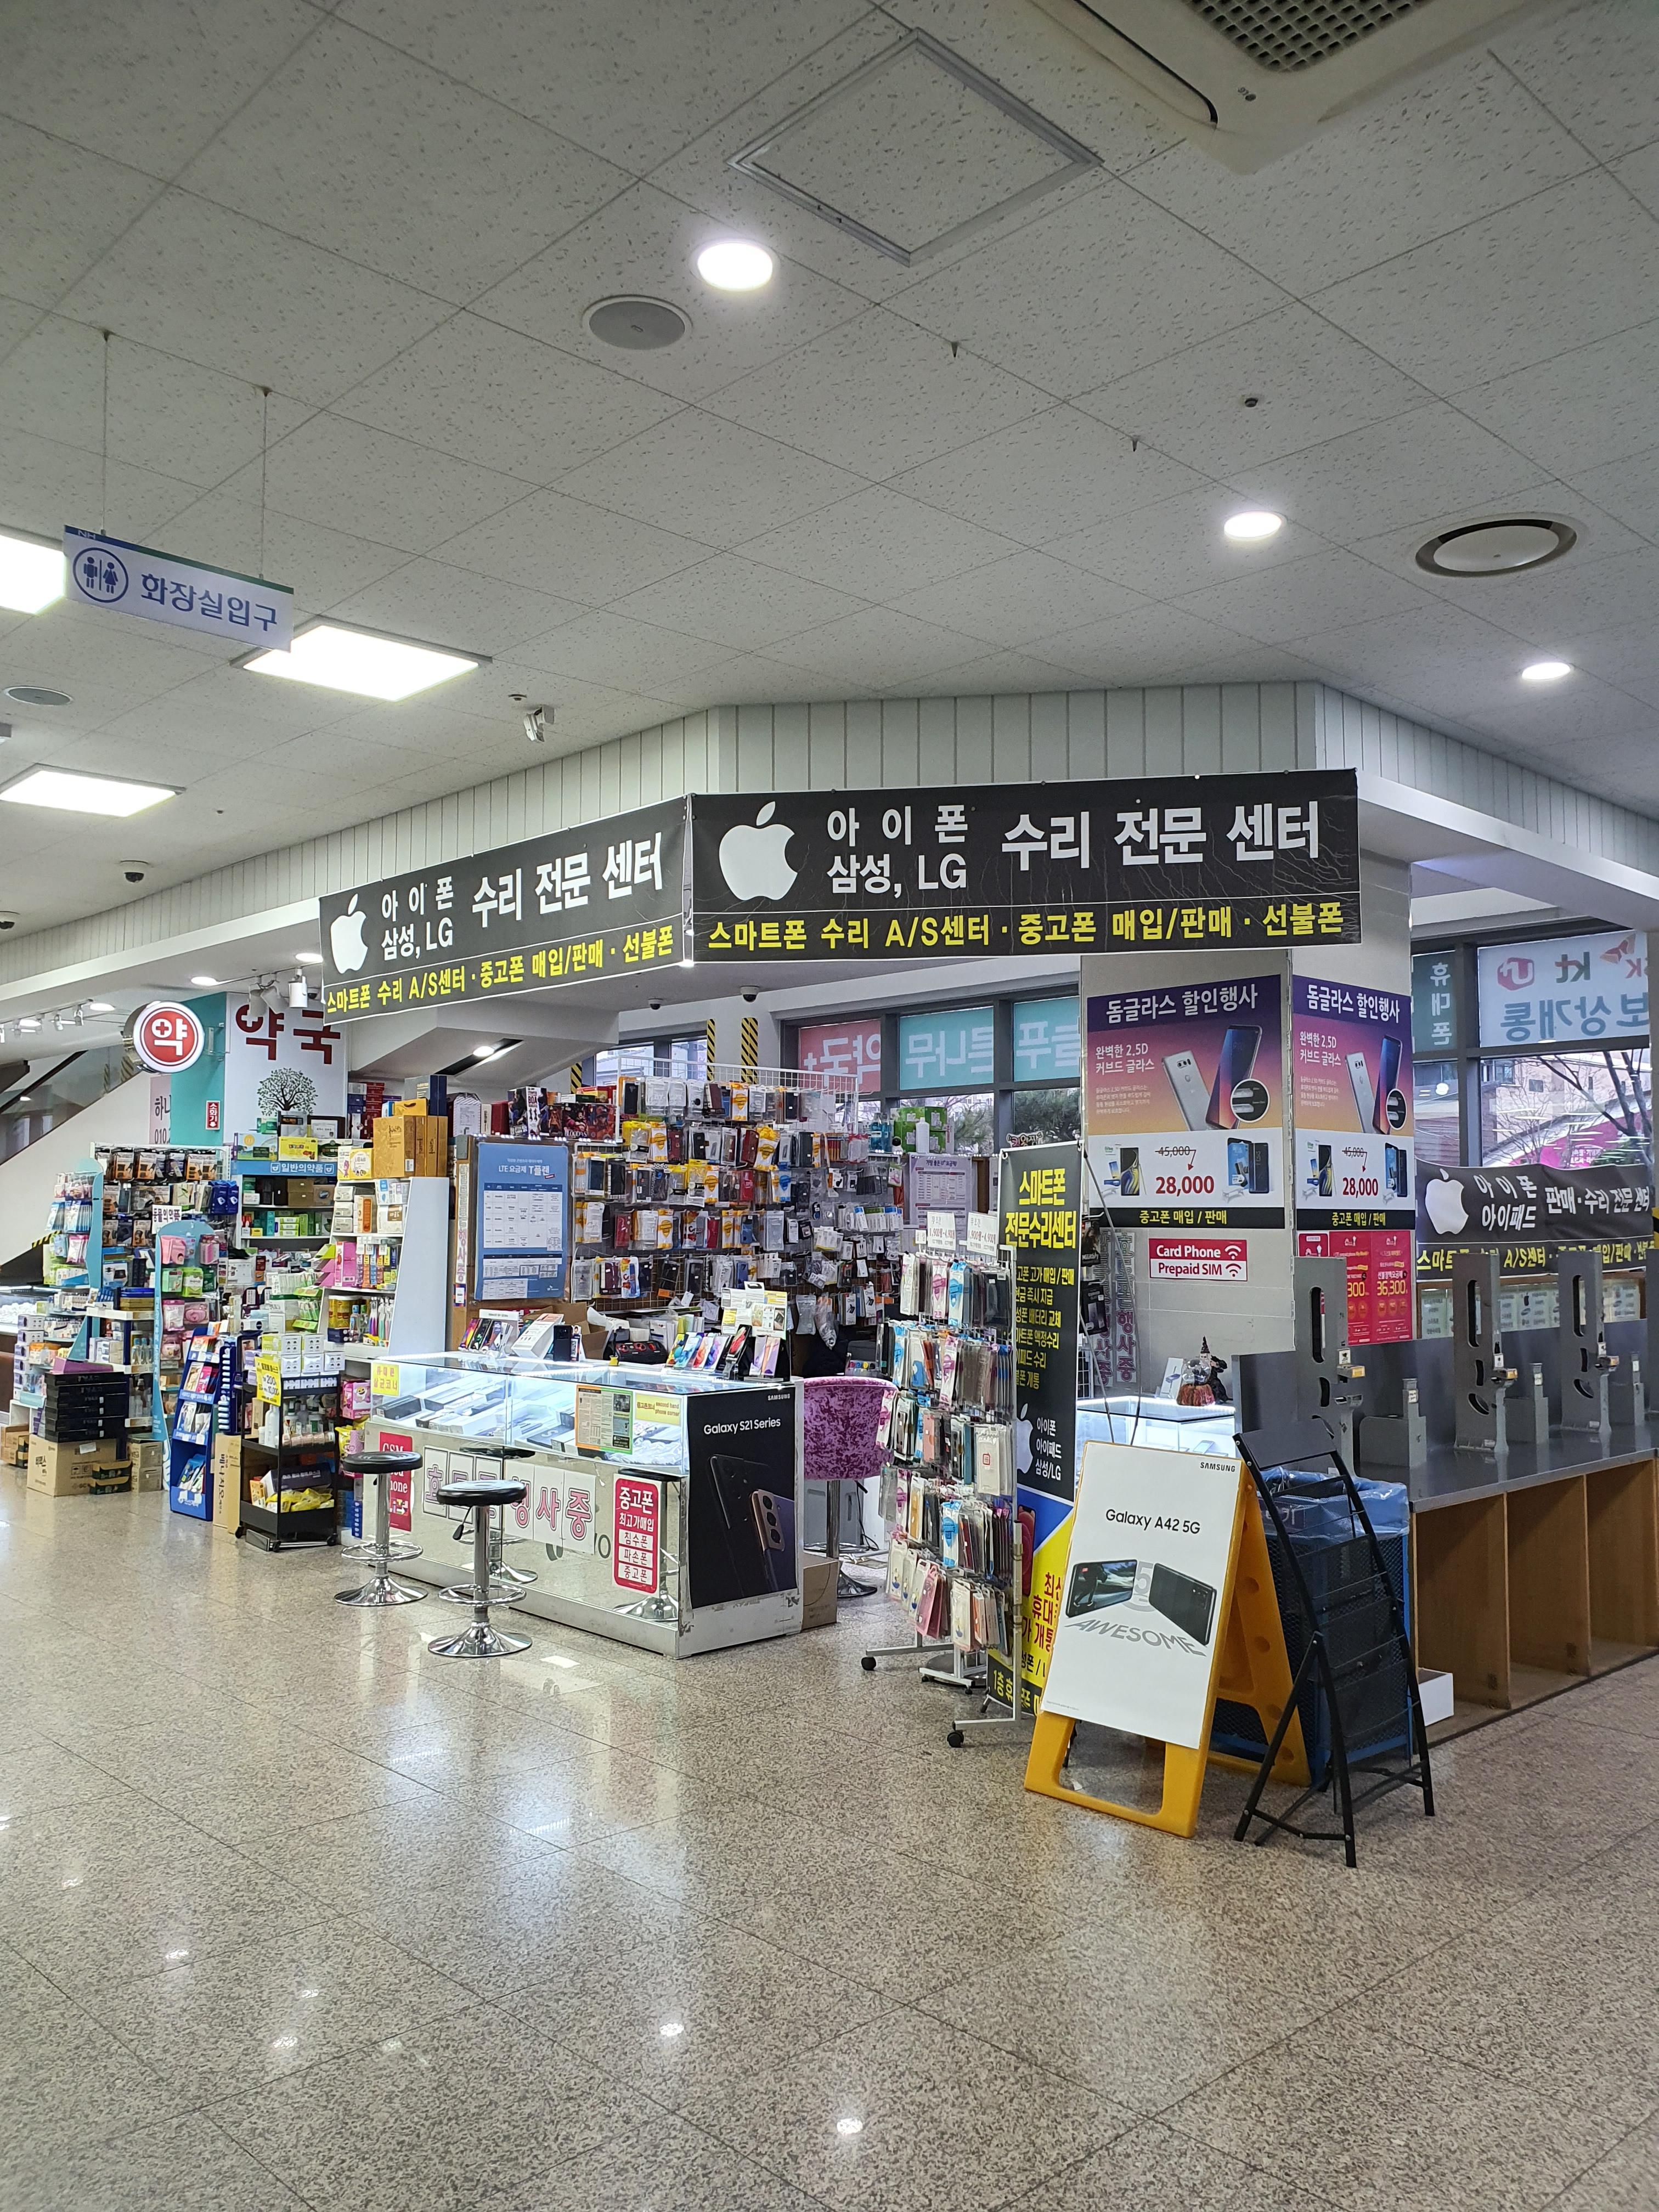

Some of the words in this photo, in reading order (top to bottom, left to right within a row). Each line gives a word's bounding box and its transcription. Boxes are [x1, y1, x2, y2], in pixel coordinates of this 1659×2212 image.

[141, 572, 276, 632] 화장실입구
[1002, 811, 1090, 871] 수리
[1114, 807, 1206, 866] 전문
[1226, 801, 1318, 862] 센터
[472, 868, 522, 927] 수리
[535, 853, 590, 915] 전문
[602, 832, 662, 900] 센터
[918, 853, 966, 890] LG
[426, 918, 453, 951] LG
[708, 919, 806, 951] 스마트폰
[821, 918, 868, 949] 수리
[885, 915, 989, 948] A/S센터
[1018, 911, 1096, 944] 중고폰
[1112, 906, 1232, 941] 매입/판매
[1262, 902, 1343, 936] 선불폰
[327, 989, 371, 1013] 스마트폰
[377, 978, 403, 1006] 수리
[409, 965, 465, 1000] A/S센터
[480, 960, 524, 989] 중고폰
[532, 939, 603, 978] 매입/판매
[623, 925, 674, 962] 선불폰
[1106, 991, 1176, 1024] 돔글라스
[1182, 984, 1258, 1017] 할인행사
[1306, 984, 1353, 1014] 돔글라스
[1356, 994, 1400, 1024] 할인행사
[151, 1017, 188, 1056] 약
[1300, 1031, 1319, 1048] 완벽한
[1095, 1045, 1124, 1060] 완벽한
[1126, 1042, 1149, 1057] 2.5D
[1300, 1049, 1320, 1063] 커브드
[1321, 1050, 1341, 1067] 글라스
[1096, 1061, 1124, 1075] 커브드
[1126, 1059, 1155, 1073] 글라스
[209, 1103, 217, 1122] 소화기
[1159, 1146, 1190, 1157] 45,000
[281, 1163, 324, 1173] 일반의약품
[528, 1165, 549, 1176] T플랜
[1019, 1168, 1066, 1206] 스마트폰
[1155, 1176, 1214, 1197] 28,000
[1342, 1177, 1378, 1197] 28,000
[1610, 1188, 1633, 1213] 전문
[1634, 1187, 1649, 1212] 센터
[1139, 1210, 1171, 1225] 중고폰
[1173, 1210, 1195, 1224] 매입
[1205, 1210, 1227, 1224] 판매
[1332, 1212, 1352, 1227] 중고폰
[1354, 1212, 1366, 1226] 매입
[1373, 1212, 1386, 1226] 판매
[1482, 1204, 1536, 1231] 아이패드
[1005, 1211, 1076, 1249] 전문수리센터
[1156, 1244, 1181, 1257] Card
[1183, 1245, 1221, 1259] Phone
[1017, 1266, 1029, 1282] 고폰
[1030, 1267, 1043, 1283] 고가
[1043, 1267, 1056, 1284] 매입
[1061, 1268, 1075, 1286] 판매
[1158, 1262, 1199, 1277] Prepaid
[1201, 1263, 1222, 1276] SIM
[1027, 1287, 1040, 1304] 즉시
[1040, 1288, 1053, 1306] 지급
[1376, 1280, 1406, 1297] 36,300
[1015, 1307, 1028, 1324] 성폰
[1029, 1308, 1047, 1326] 배터리
[1048, 1310, 1062, 1328] 교체
[1015, 1328, 1034, 1345] 마트폰
[1034, 1330, 1059, 1350] 액정수리
[1117, 1310, 1136, 1383] 행사중
[1015, 1348, 1033, 1366] 이패드
[1034, 1352, 1046, 1369] 수리
[1026, 1372, 1040, 1390] 개통
[704, 1423, 738, 1435] Galaxy
[740, 1420, 753, 1431] S21
[754, 1417, 781, 1429] Series
[1037, 1417, 1056, 1437] 아이폰
[1036, 1438, 1062, 1459] 아이패드
[1035, 1459, 1061, 1481] 삼성/LG
[1200, 1462, 1235, 1472] SAMSUNG
[619, 1486, 653, 1514] 중고폰
[619, 1513, 654, 1532] 최고가매입
[1106, 1509, 1152, 1531] Galaxy
[1155, 1516, 1179, 1531] A42
[1182, 1521, 1200, 1534] 5G
[624, 1532, 647, 1548] 침수폰
[624, 1549, 647, 1565] 파손폰
[624, 1566, 647, 1583] 중고폰
[1032, 1595, 1058, 1626] 휴대
[1064, 1619, 1206, 1657] AWESOME
